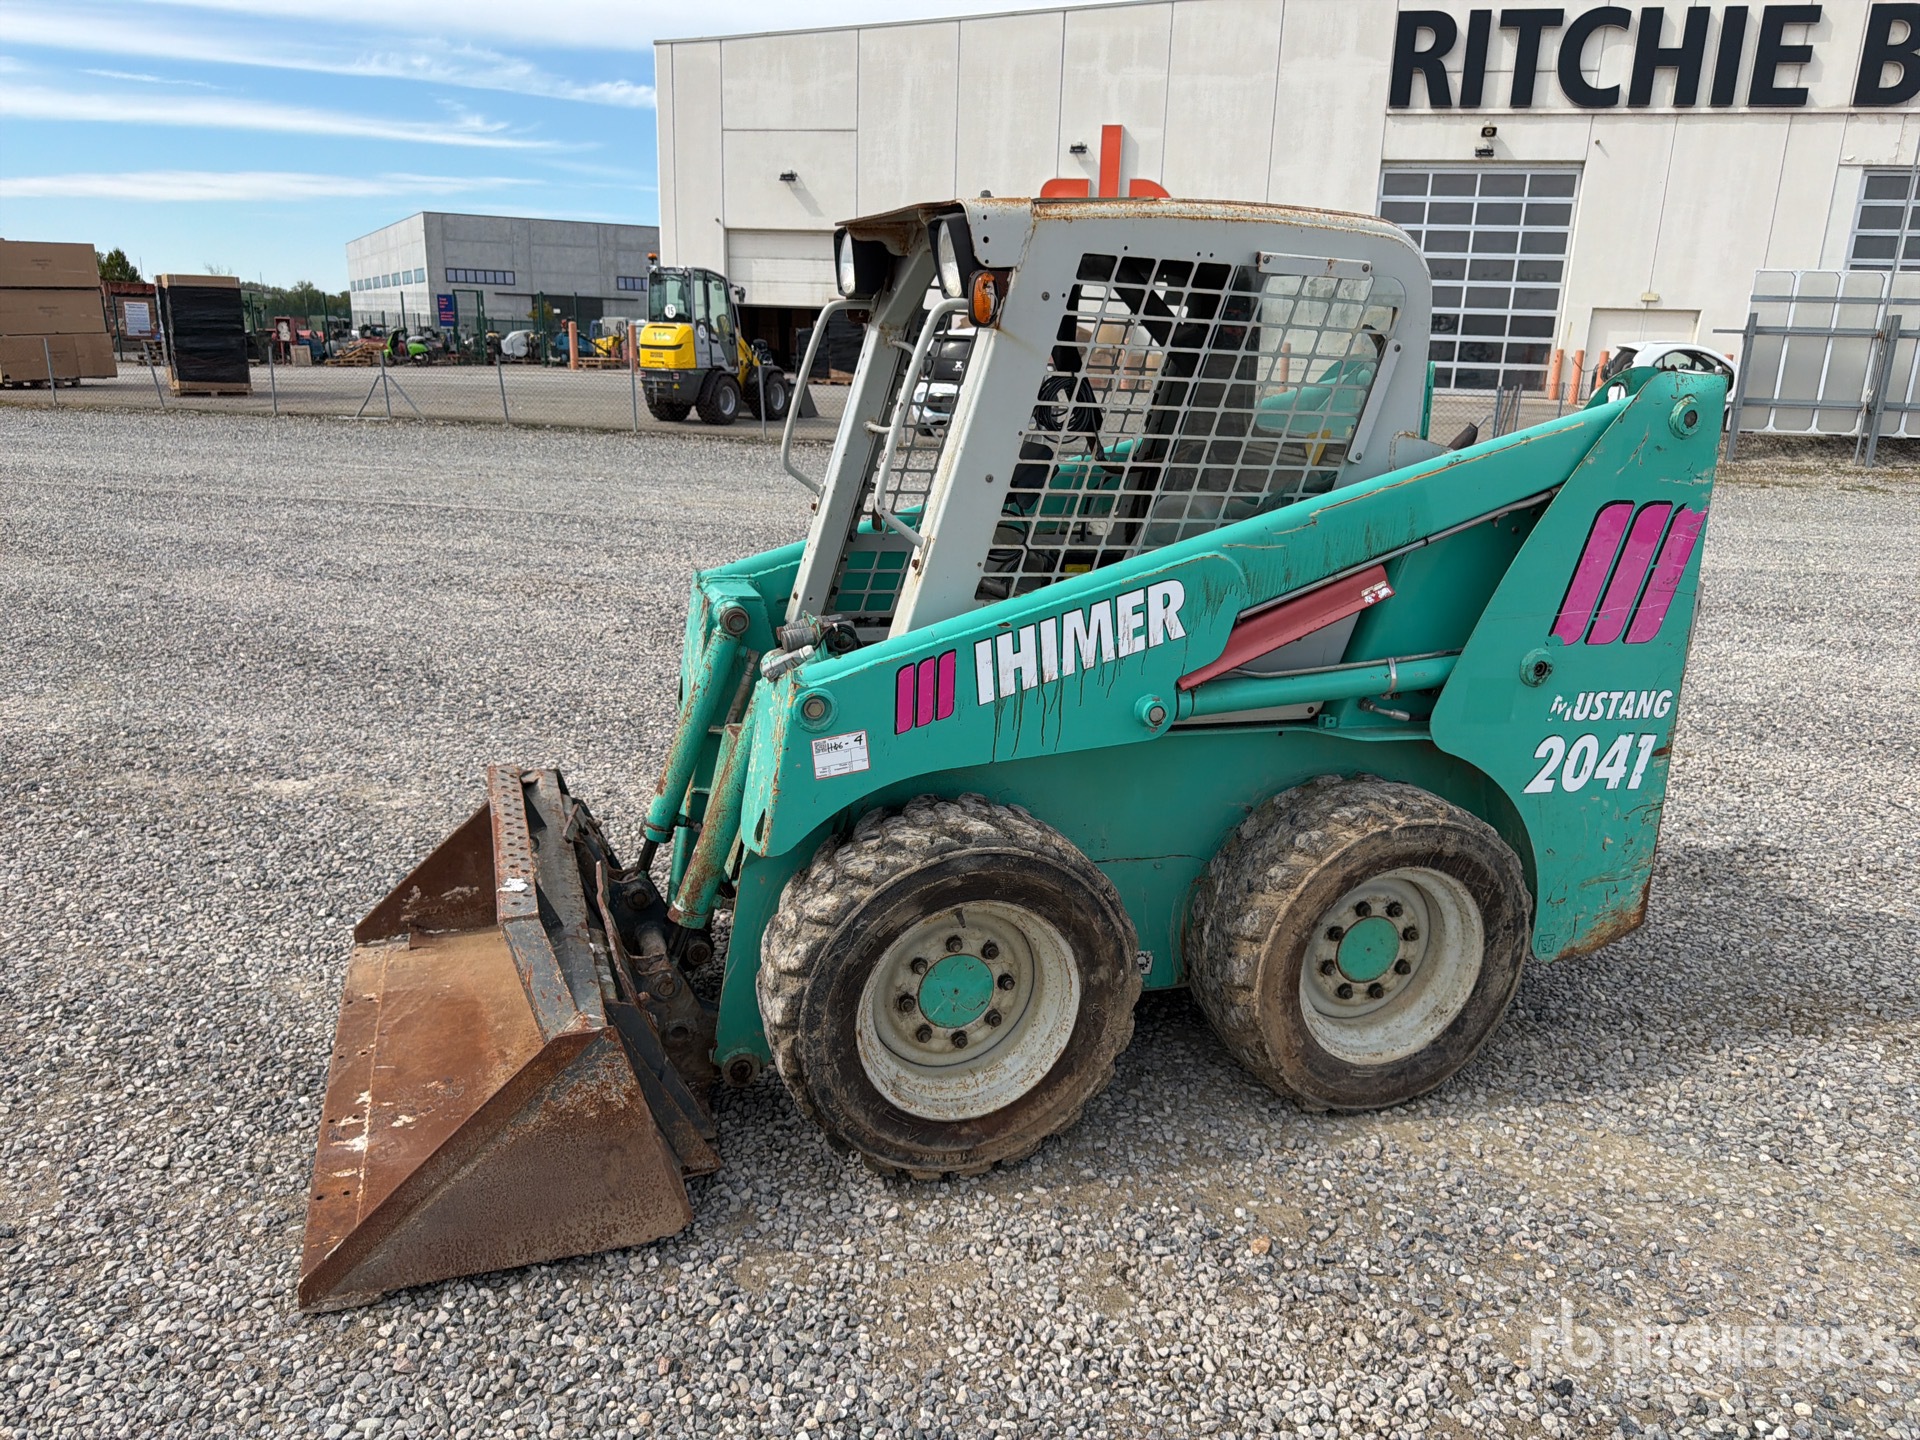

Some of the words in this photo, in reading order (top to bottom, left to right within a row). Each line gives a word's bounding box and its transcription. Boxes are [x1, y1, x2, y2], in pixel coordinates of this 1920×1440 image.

[1389, 5, 1823, 108] RITCHIE
[1852, 3, 1920, 107] B
[975, 579, 1187, 706] IHIMER
[1522, 732, 1658, 794] 2041
